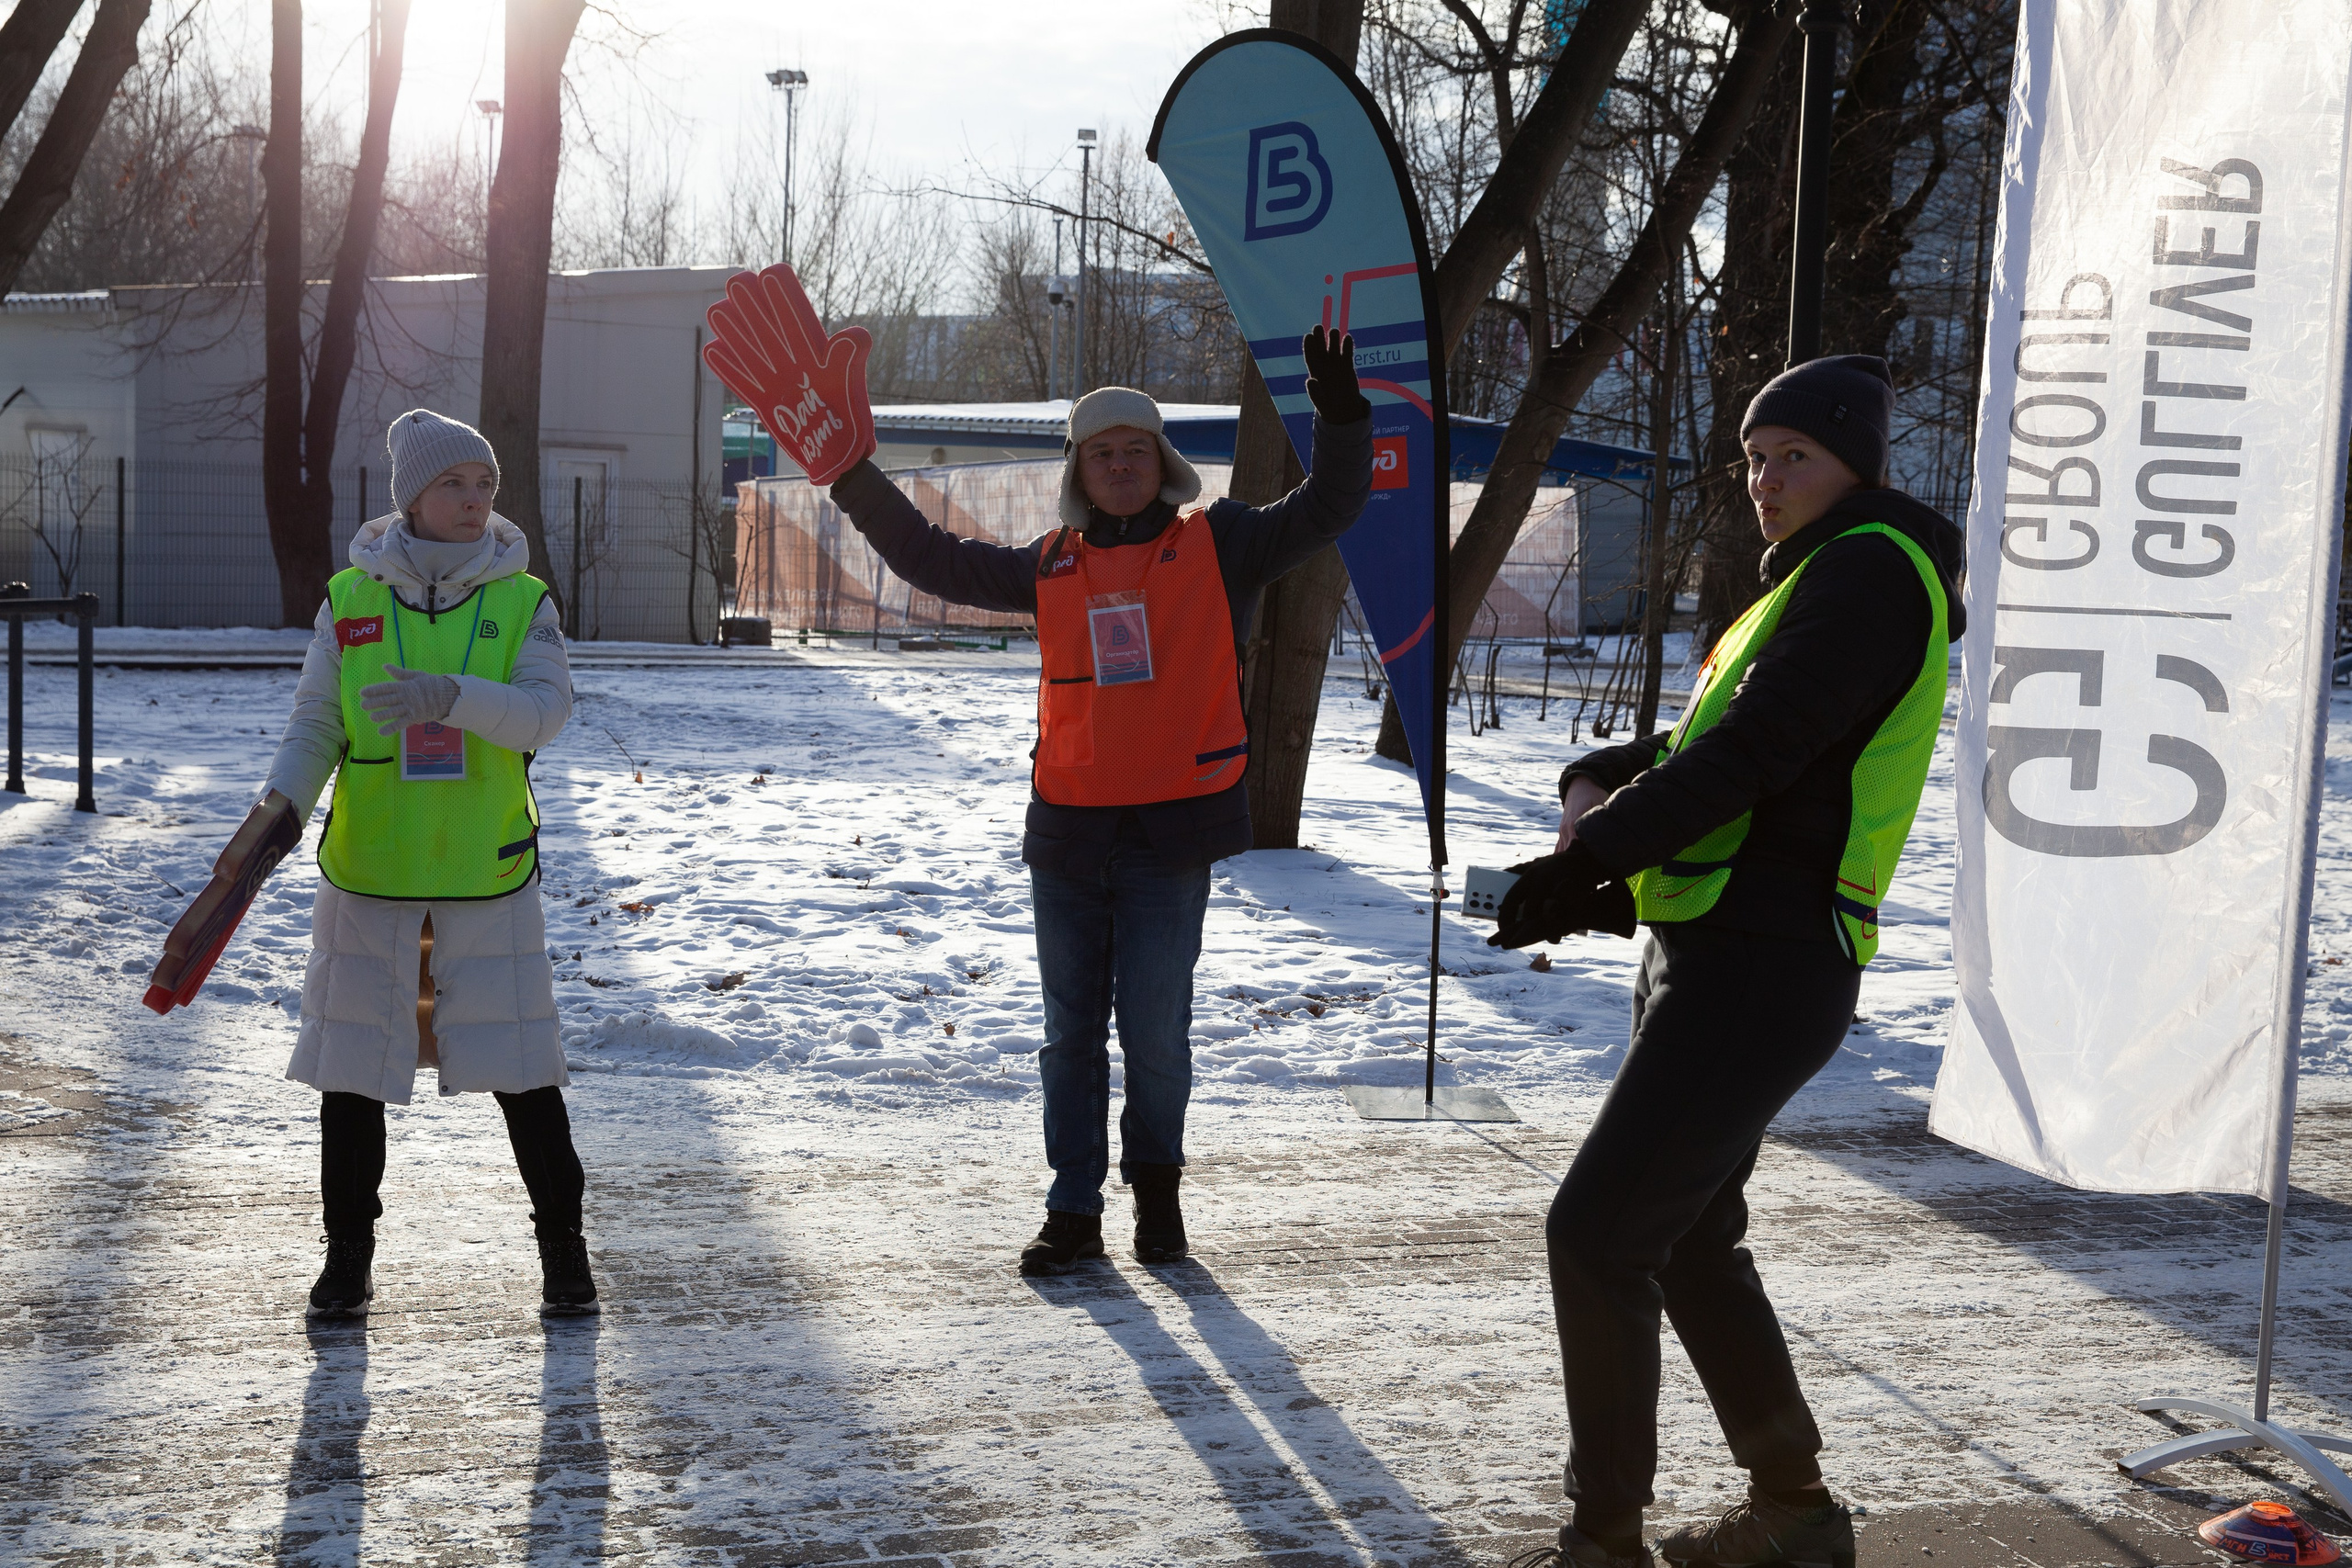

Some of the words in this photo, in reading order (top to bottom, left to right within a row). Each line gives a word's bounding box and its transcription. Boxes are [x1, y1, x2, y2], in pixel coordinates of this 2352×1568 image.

[1354, 349, 1401, 367] erst.ru
[773, 371, 826, 443] Дай
[798, 409, 843, 465] пять
[534, 634, 564, 650] adidas
[1105, 649, 1139, 659] Организатор
